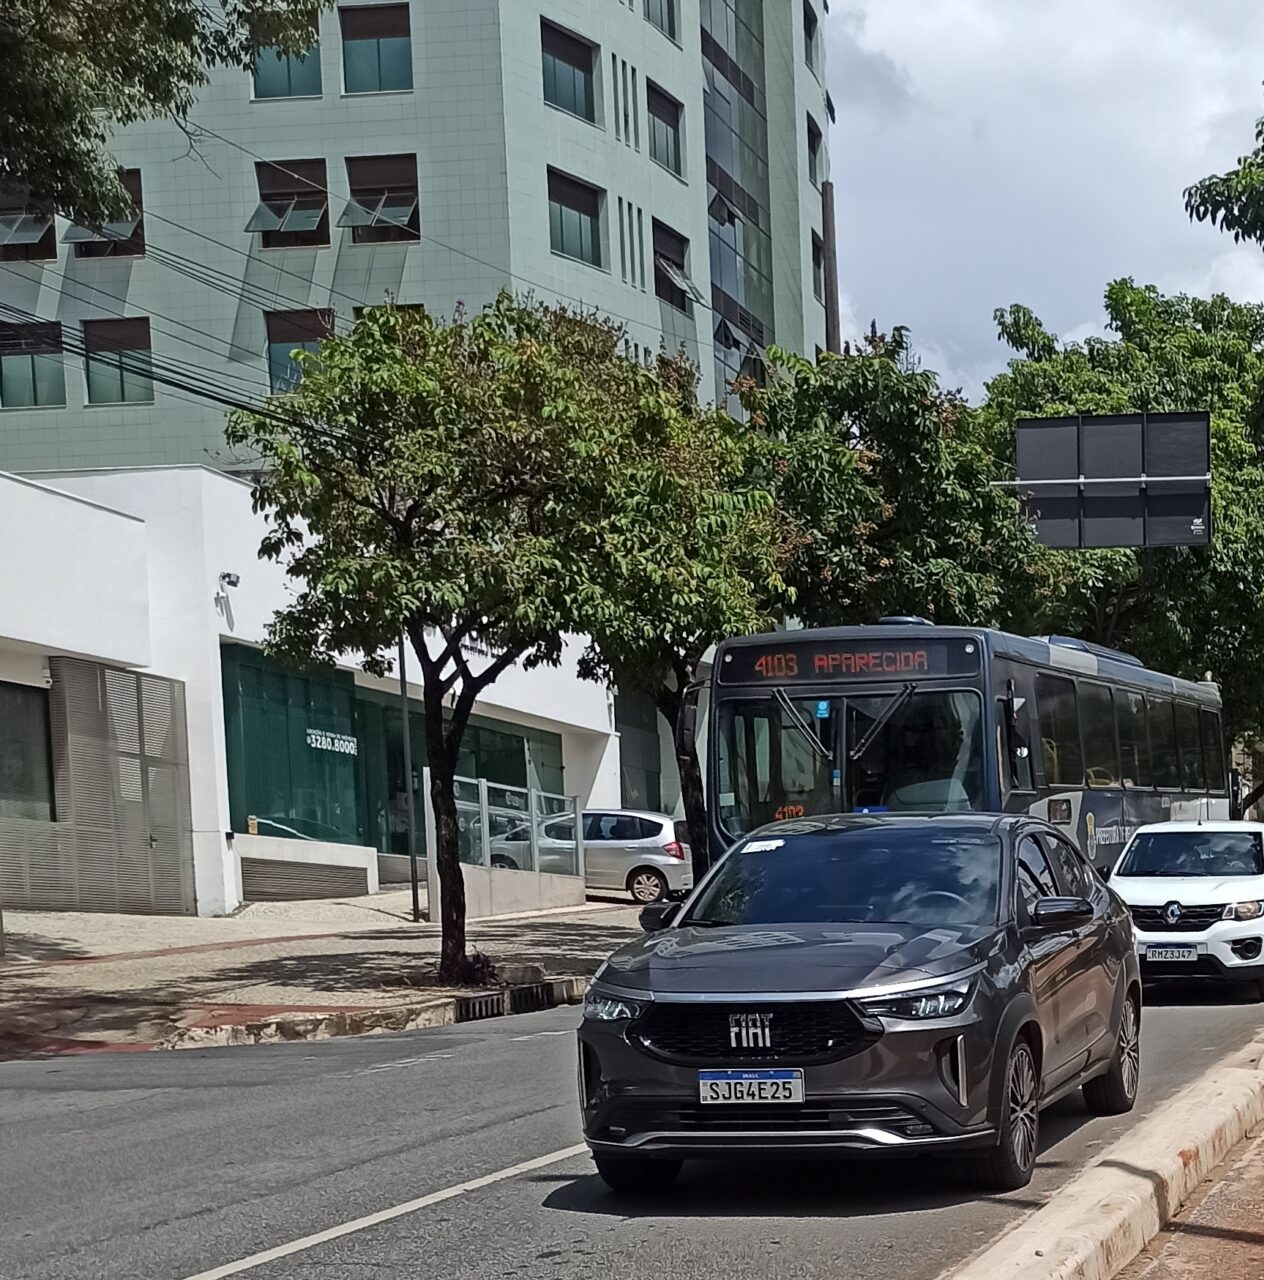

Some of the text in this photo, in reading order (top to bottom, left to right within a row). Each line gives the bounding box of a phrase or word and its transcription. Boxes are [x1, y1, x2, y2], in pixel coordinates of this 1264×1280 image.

[754, 650, 928, 678] 4103 APARECIDA
[311, 735, 355, 755] 3280.8000
[728, 1012, 774, 1048] FIAT
[709, 1080, 793, 1101] SJG4E25
